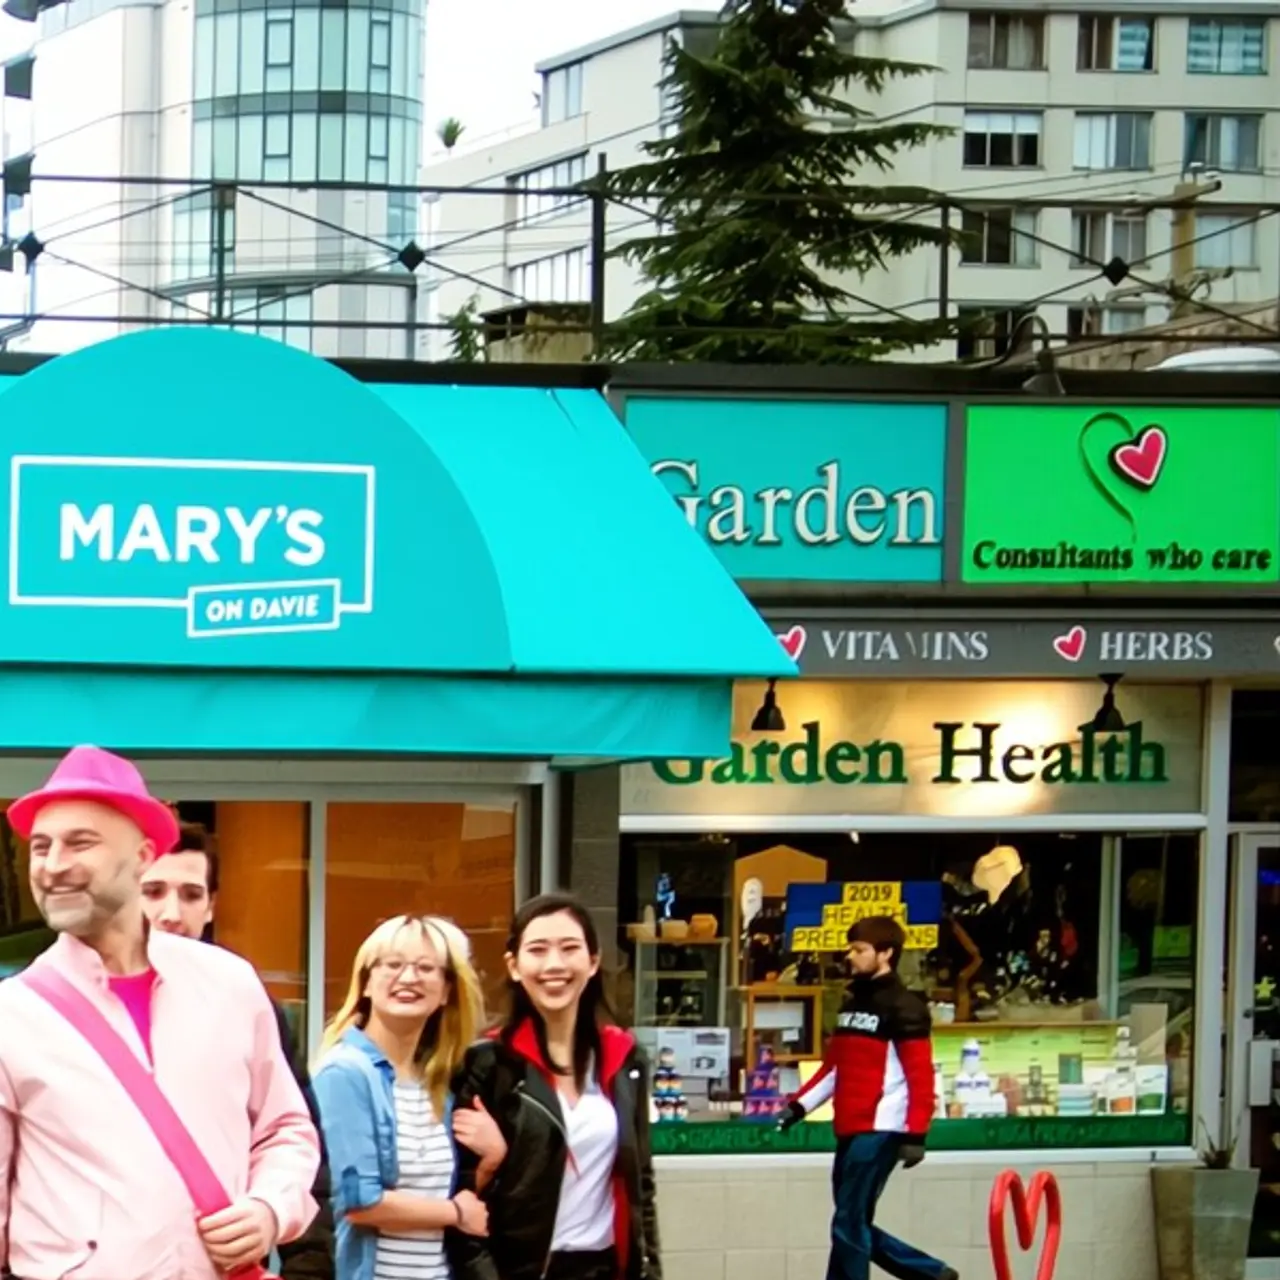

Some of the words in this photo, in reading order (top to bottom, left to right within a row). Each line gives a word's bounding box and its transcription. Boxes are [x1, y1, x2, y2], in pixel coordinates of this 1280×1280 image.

[59, 503, 326, 566] MARY'S
[972, 540, 1134, 570] Consultants
[1145, 541, 1203, 570] who
[1211, 548, 1273, 571] care
[205, 599, 243, 623] ON
[249, 594, 320, 621] DAVIE
[1098, 631, 1214, 661] HERBS
[931, 721, 1169, 786] Health
[849, 885, 894, 902] 2019
